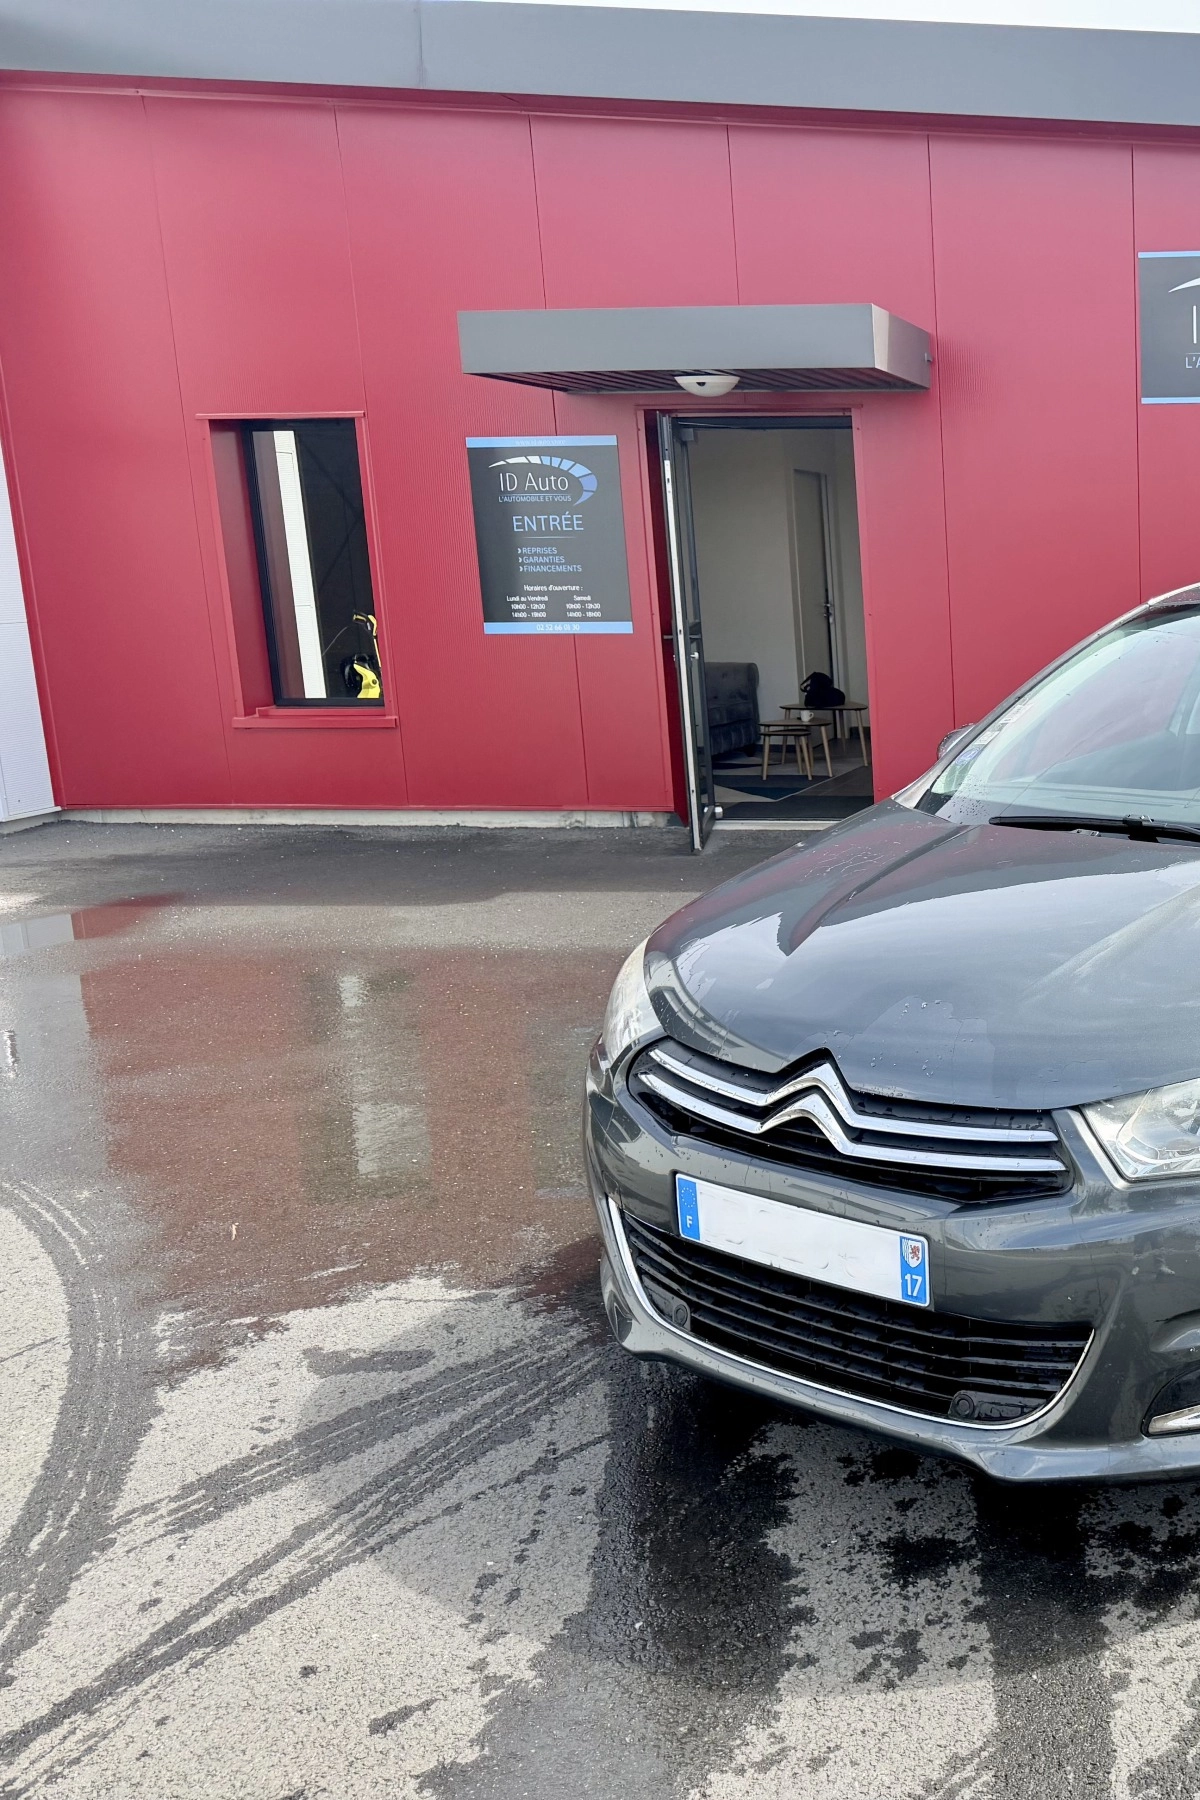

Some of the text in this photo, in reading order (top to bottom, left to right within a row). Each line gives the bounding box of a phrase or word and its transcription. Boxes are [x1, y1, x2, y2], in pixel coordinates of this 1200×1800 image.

[499, 472, 569, 492] ID Auto
[498, 495, 544, 503] L'AUTOMOBILE
[512, 511, 584, 532] ENTRÉE
[522, 547, 558, 555] REPRISES
[685, 1215, 923, 1297] F 17
